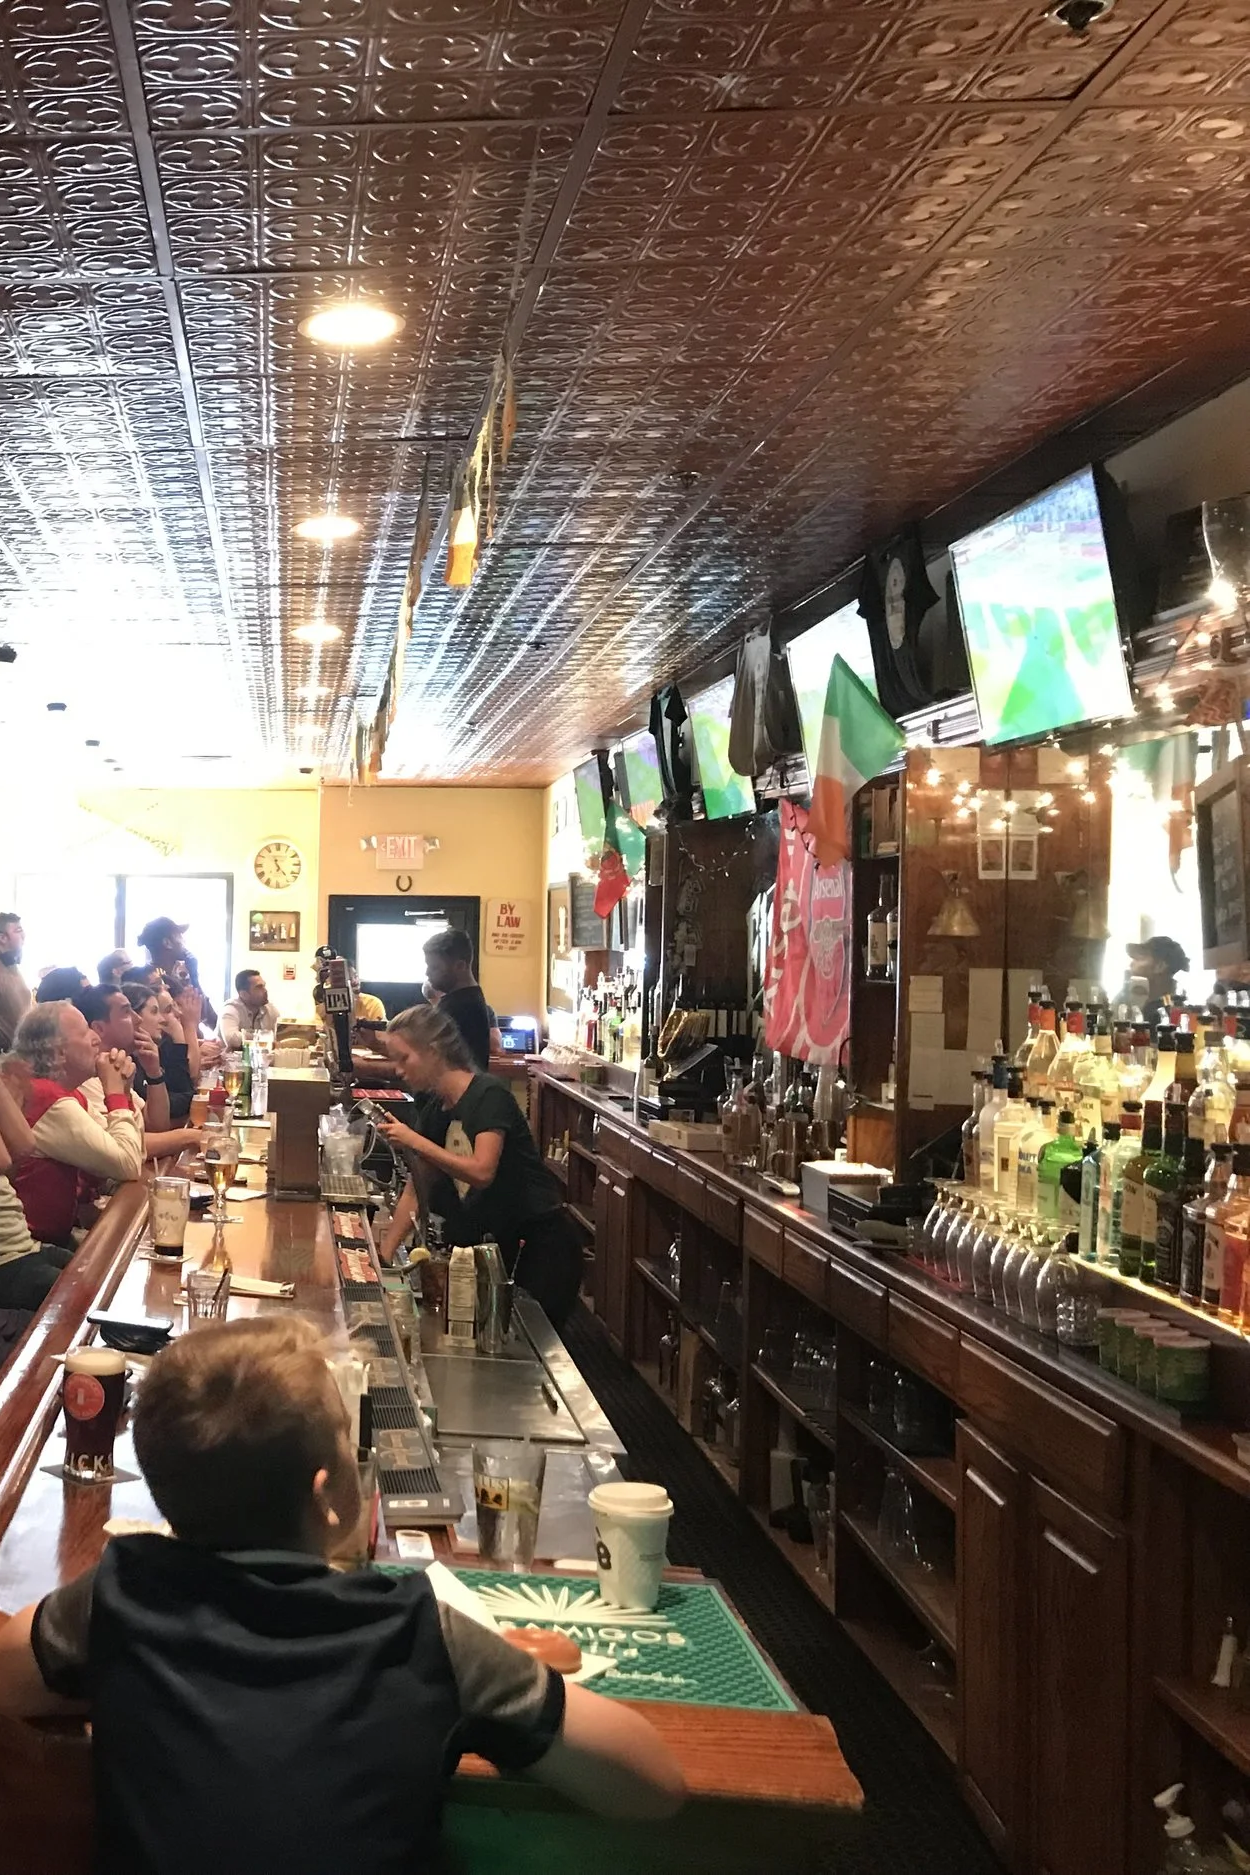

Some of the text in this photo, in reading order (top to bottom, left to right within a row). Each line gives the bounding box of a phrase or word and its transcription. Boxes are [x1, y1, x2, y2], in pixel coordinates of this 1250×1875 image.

[387, 836, 417, 859] EXIT
[812, 877, 845, 900] Arsenal
[500, 903, 516, 915] BY
[497, 916, 521, 928] LAW
[327, 993, 349, 1009] IPA
